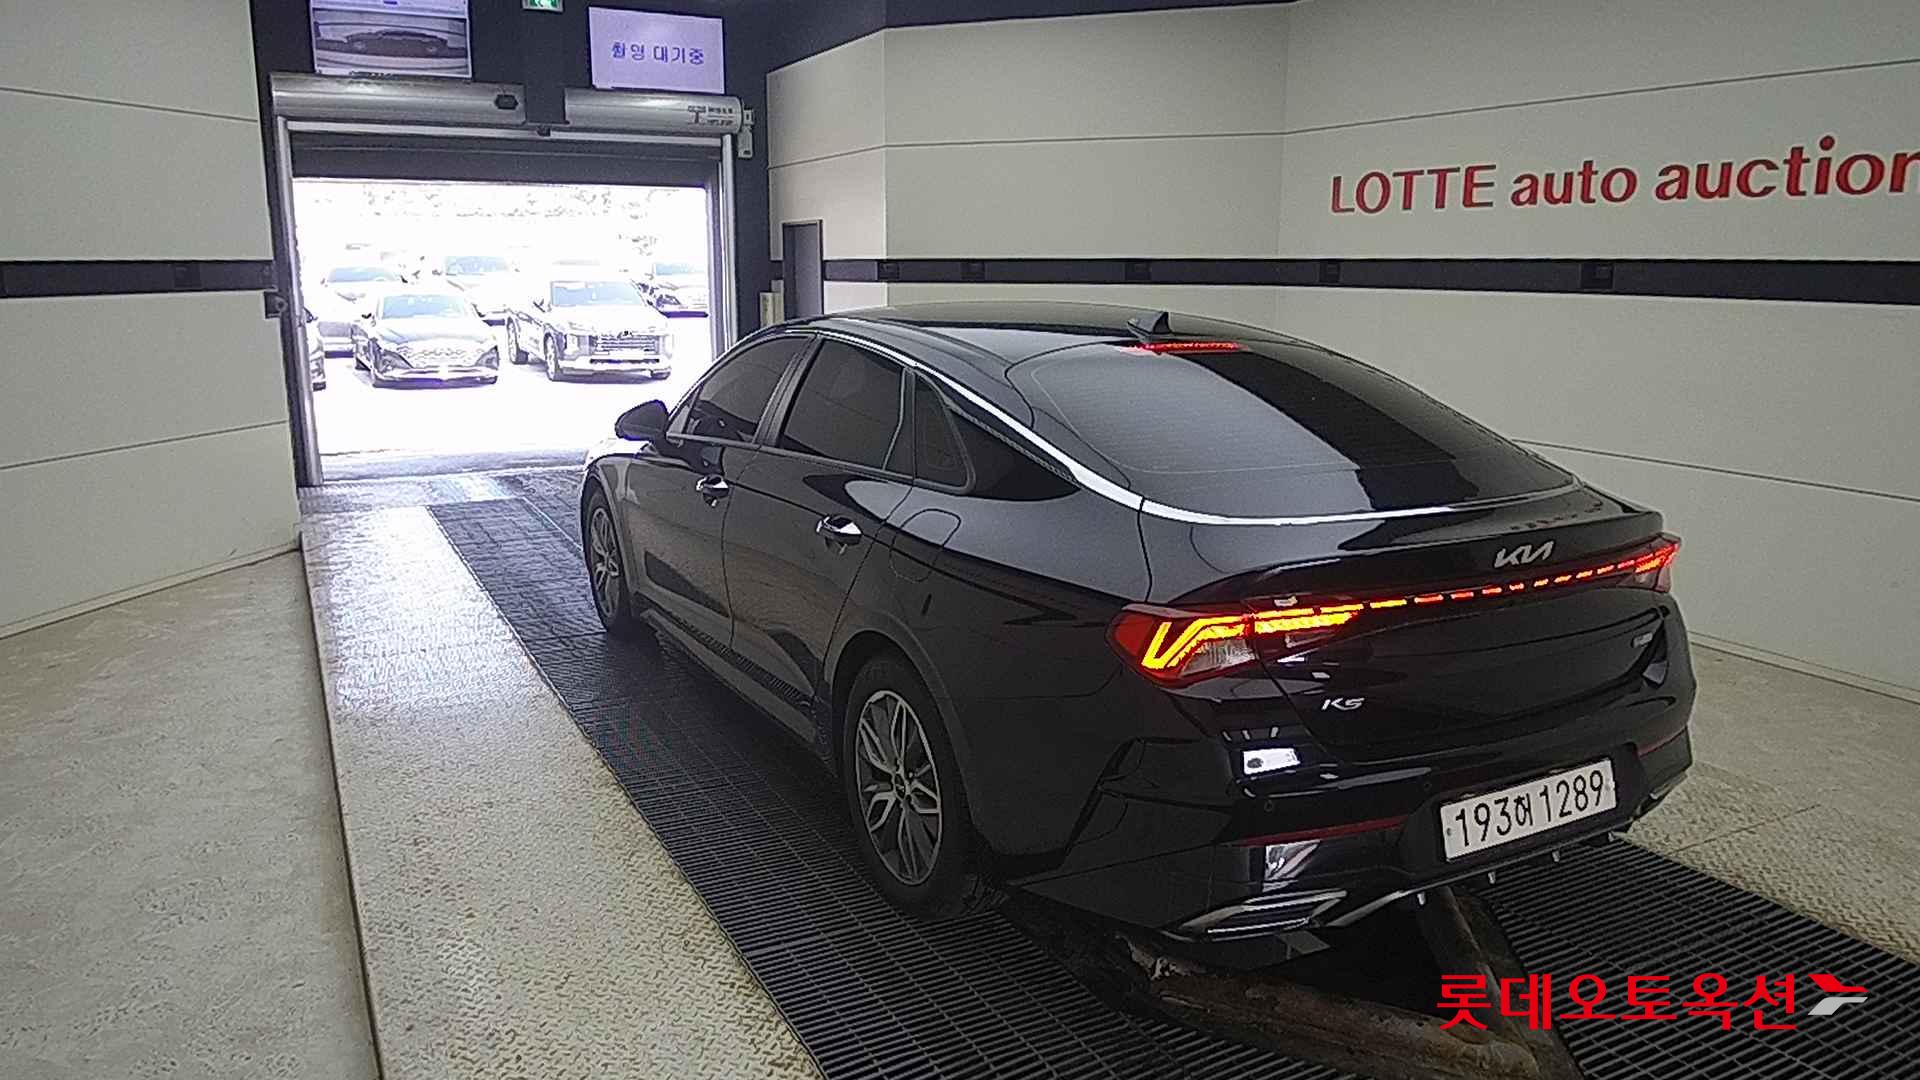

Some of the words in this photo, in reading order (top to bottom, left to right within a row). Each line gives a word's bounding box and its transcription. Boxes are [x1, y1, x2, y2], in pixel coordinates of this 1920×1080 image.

[653, 46, 704, 65] 대기중
[1331, 164, 1496, 214] LOTTE
[1510, 160, 1638, 207] auto
[1321, 698, 1365, 710] K5
[1540, 770, 1603, 822] 1289
